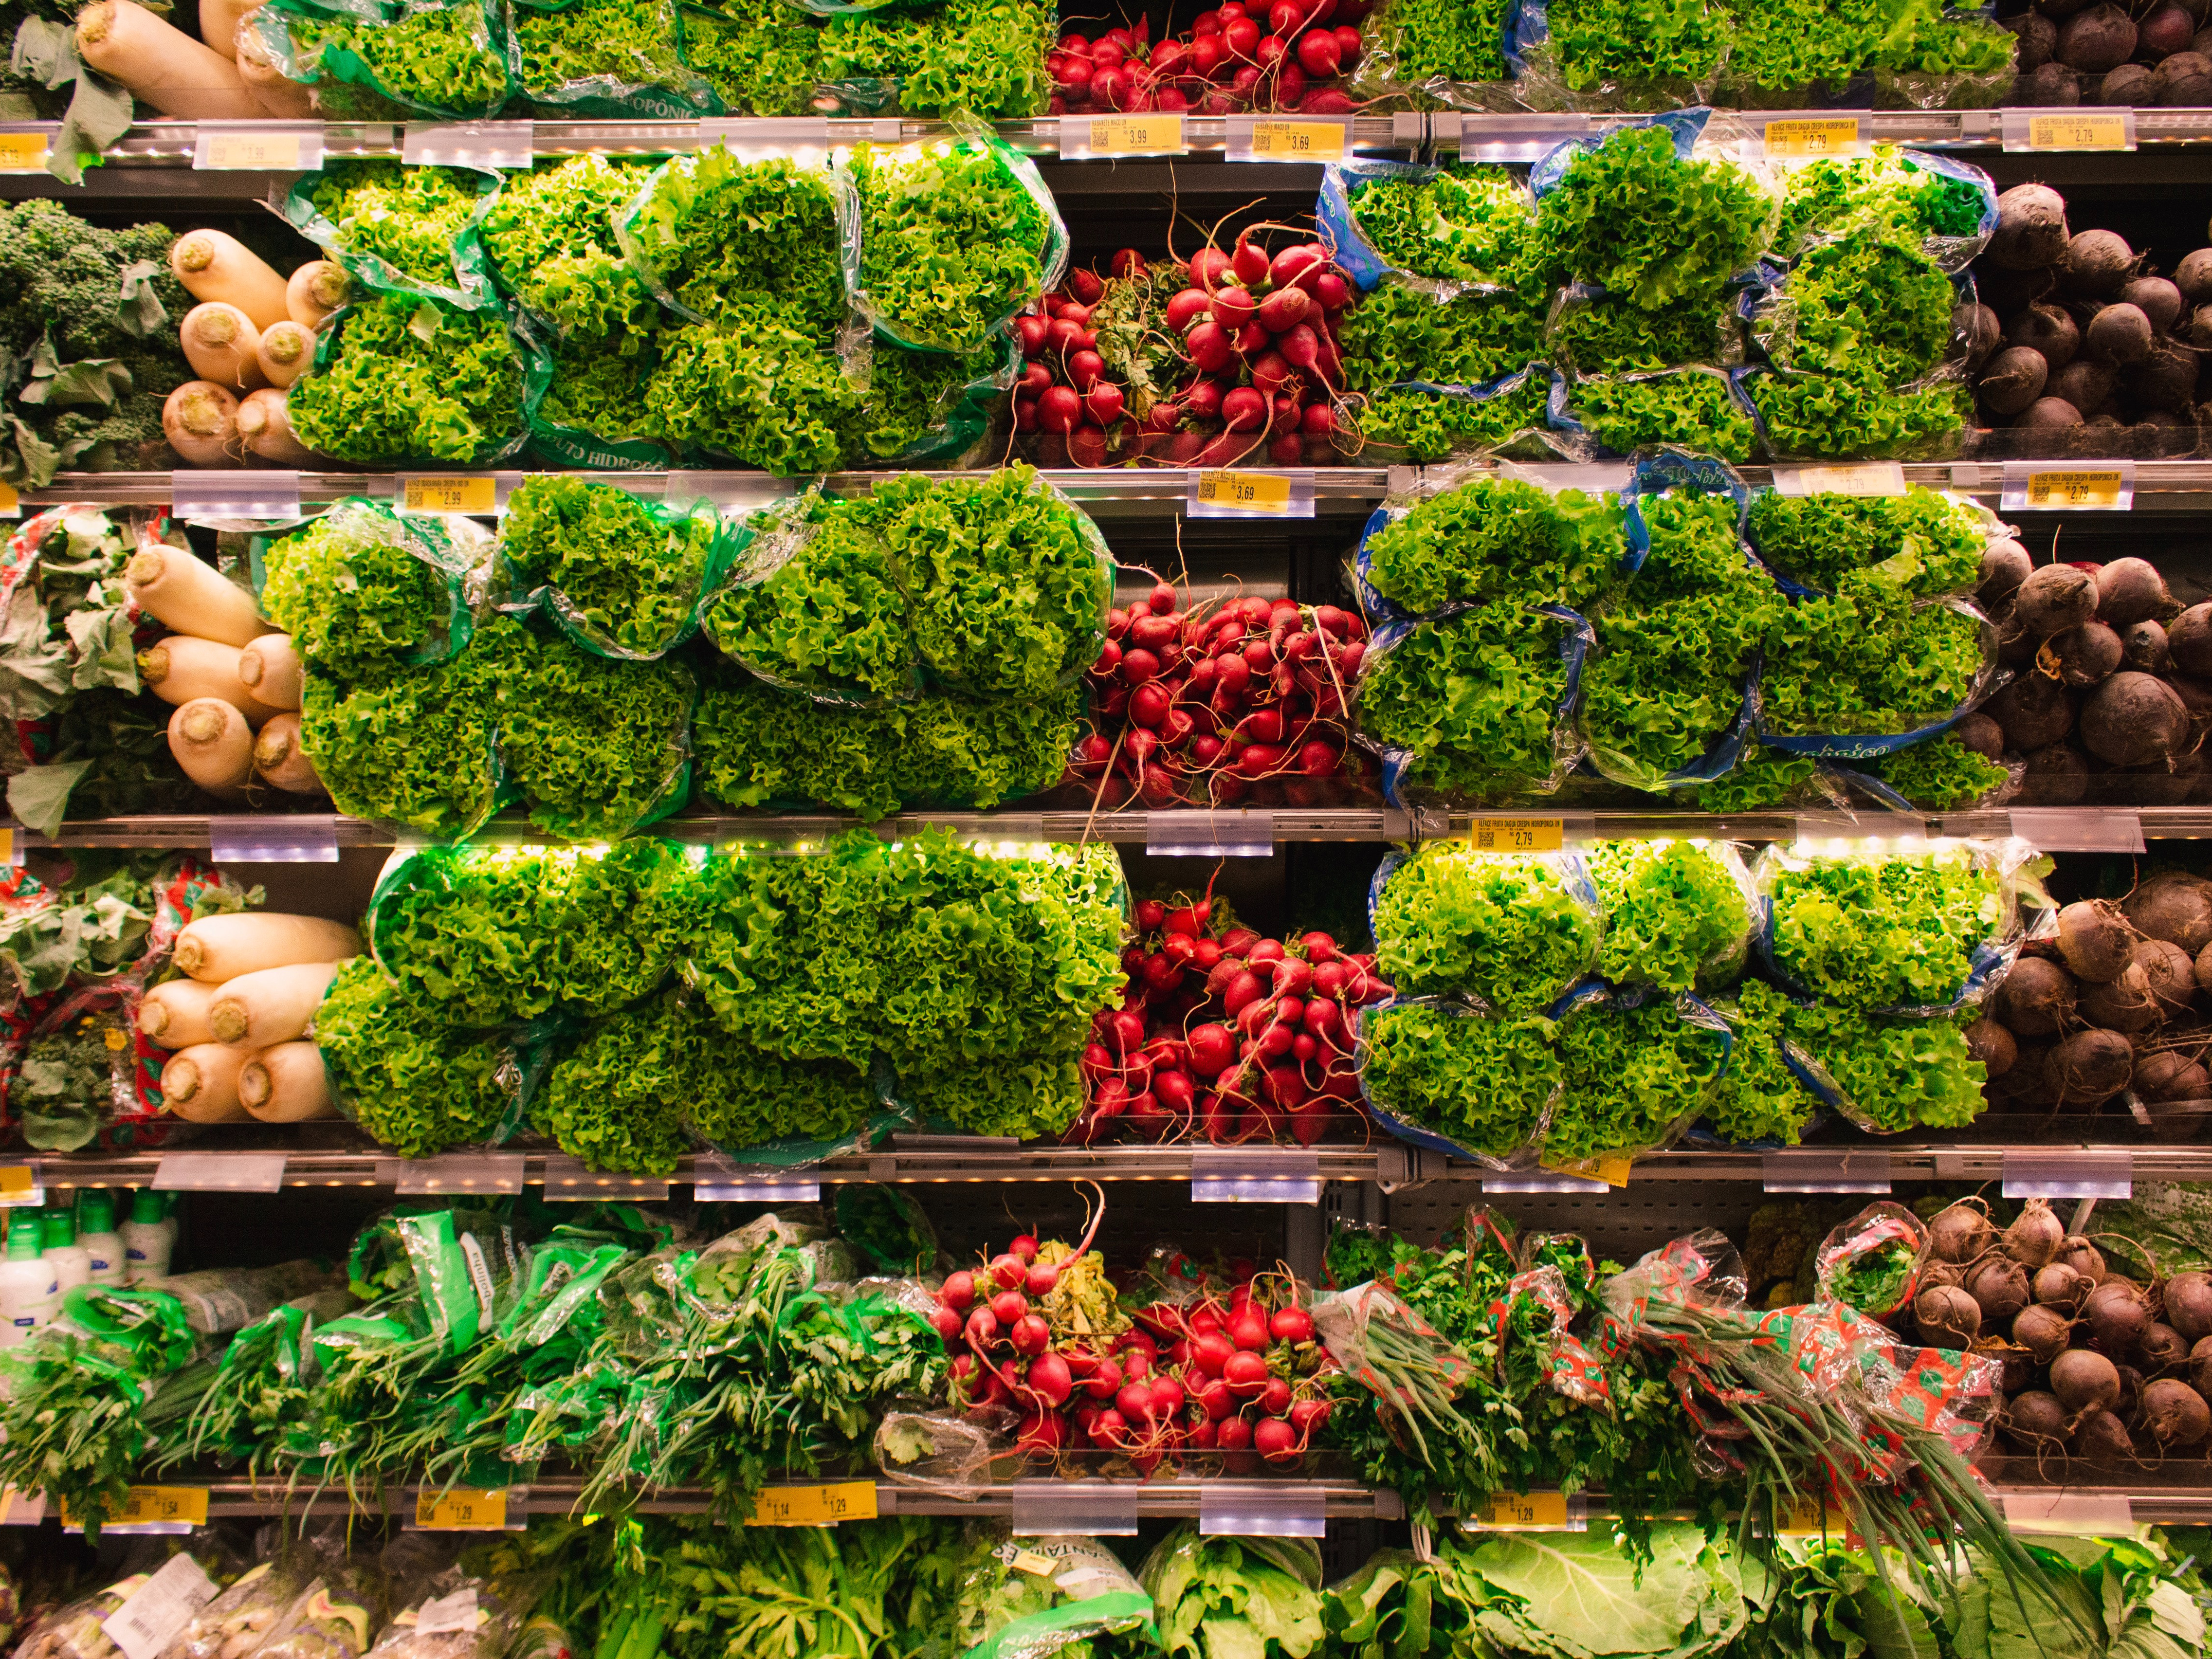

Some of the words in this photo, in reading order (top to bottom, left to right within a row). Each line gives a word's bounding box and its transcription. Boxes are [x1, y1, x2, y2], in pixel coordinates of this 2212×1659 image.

[1130, 129, 1146, 145] 3,99
[1292, 136, 1309, 151] 3,69
[1809, 134, 1826, 150] 2,79
[1201, 471, 1219, 479] RABANETE
[1237, 485, 1254, 501] 3,69
[2071, 485, 2089, 501] 2,79
[1516, 832, 1532, 847] 2,79
[1517, 1507, 1533, 1523] 1,29
